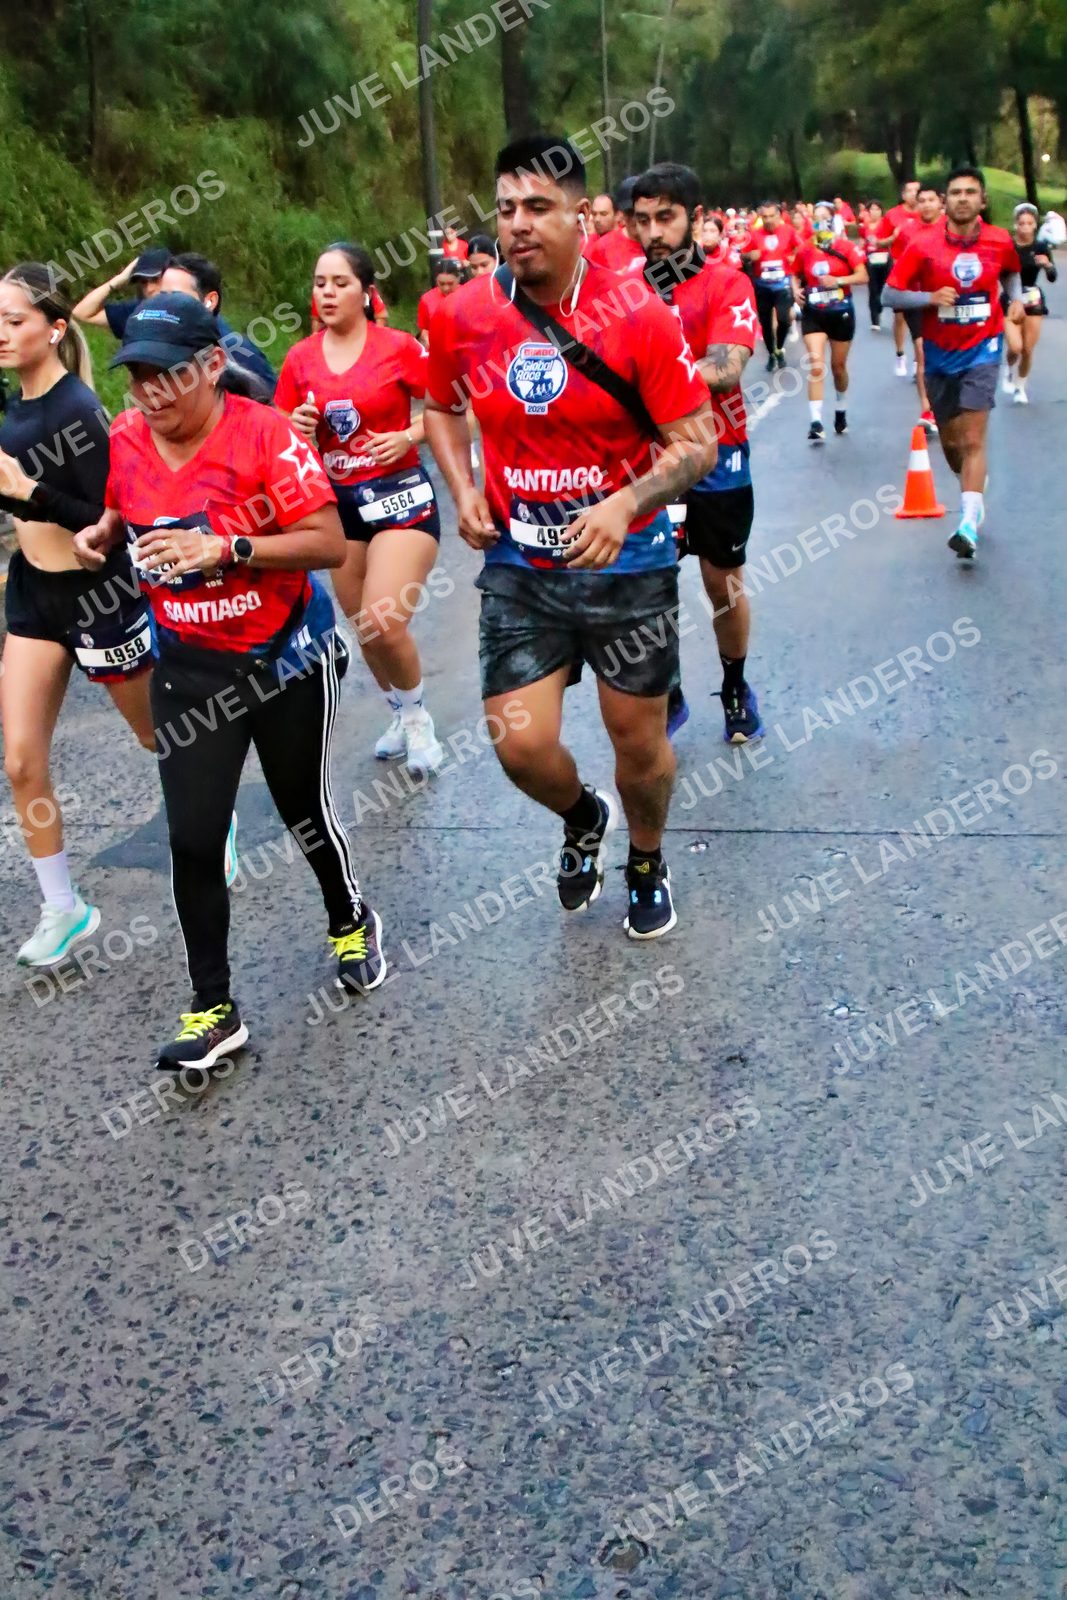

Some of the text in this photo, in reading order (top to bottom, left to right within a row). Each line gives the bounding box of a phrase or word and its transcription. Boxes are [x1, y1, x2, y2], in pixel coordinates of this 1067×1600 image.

[516, 369, 541, 380] Race
[523, 360, 554, 371] Global
[504, 465, 603, 492] SANTIAGO
[381, 490, 415, 515] 5564
[536, 527, 583, 546] 49
[163, 590, 262, 624] SANTIAGO
[104, 636, 147, 665] 4958
